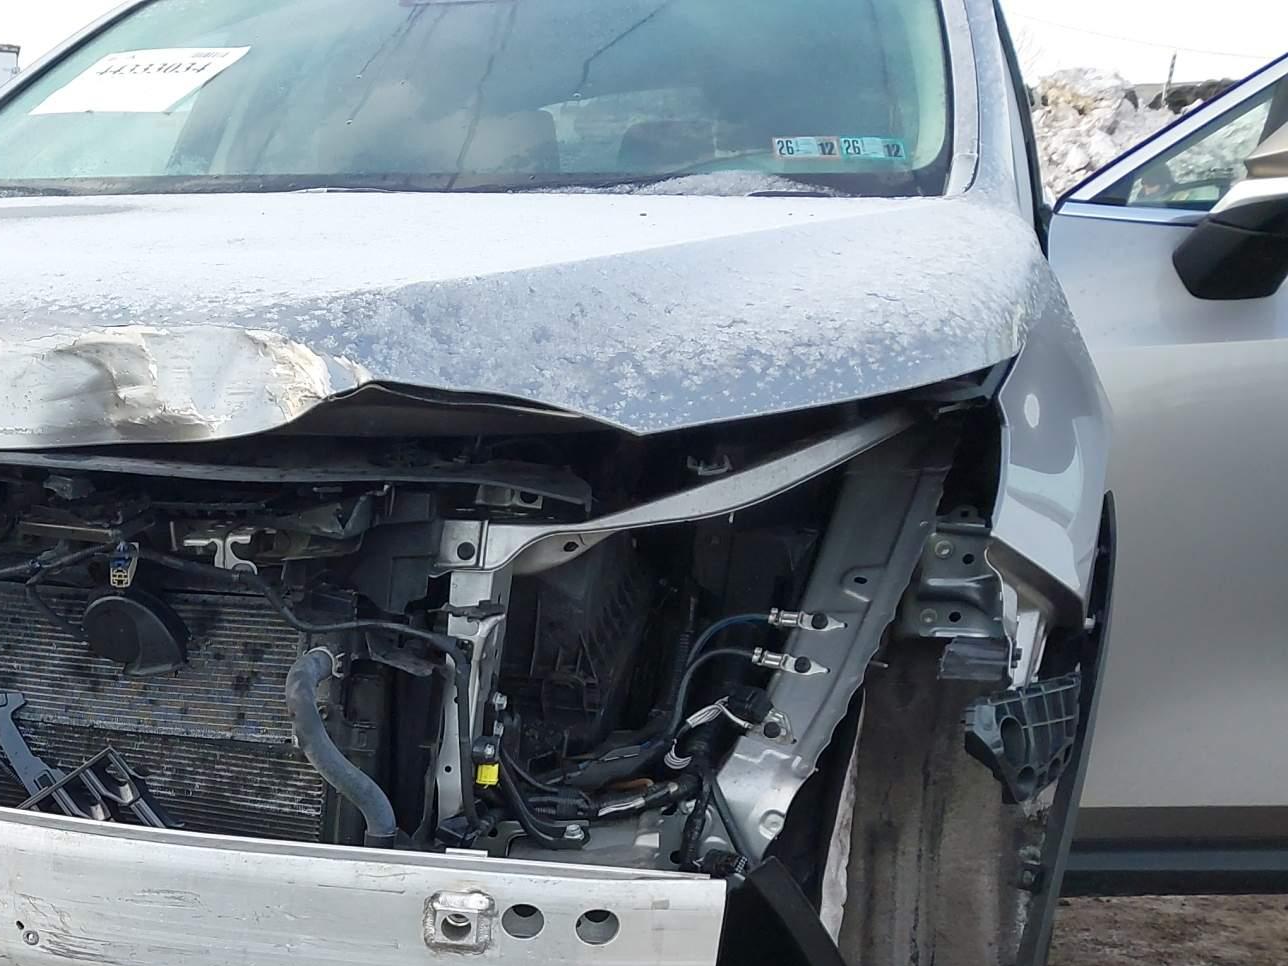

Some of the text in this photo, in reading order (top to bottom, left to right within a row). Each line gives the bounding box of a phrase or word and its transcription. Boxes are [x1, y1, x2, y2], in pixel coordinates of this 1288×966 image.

[776, 139, 795, 156] 26
[817, 141, 836, 156] 12
[842, 139, 861, 155] 26
[884, 143, 904, 157] 12
